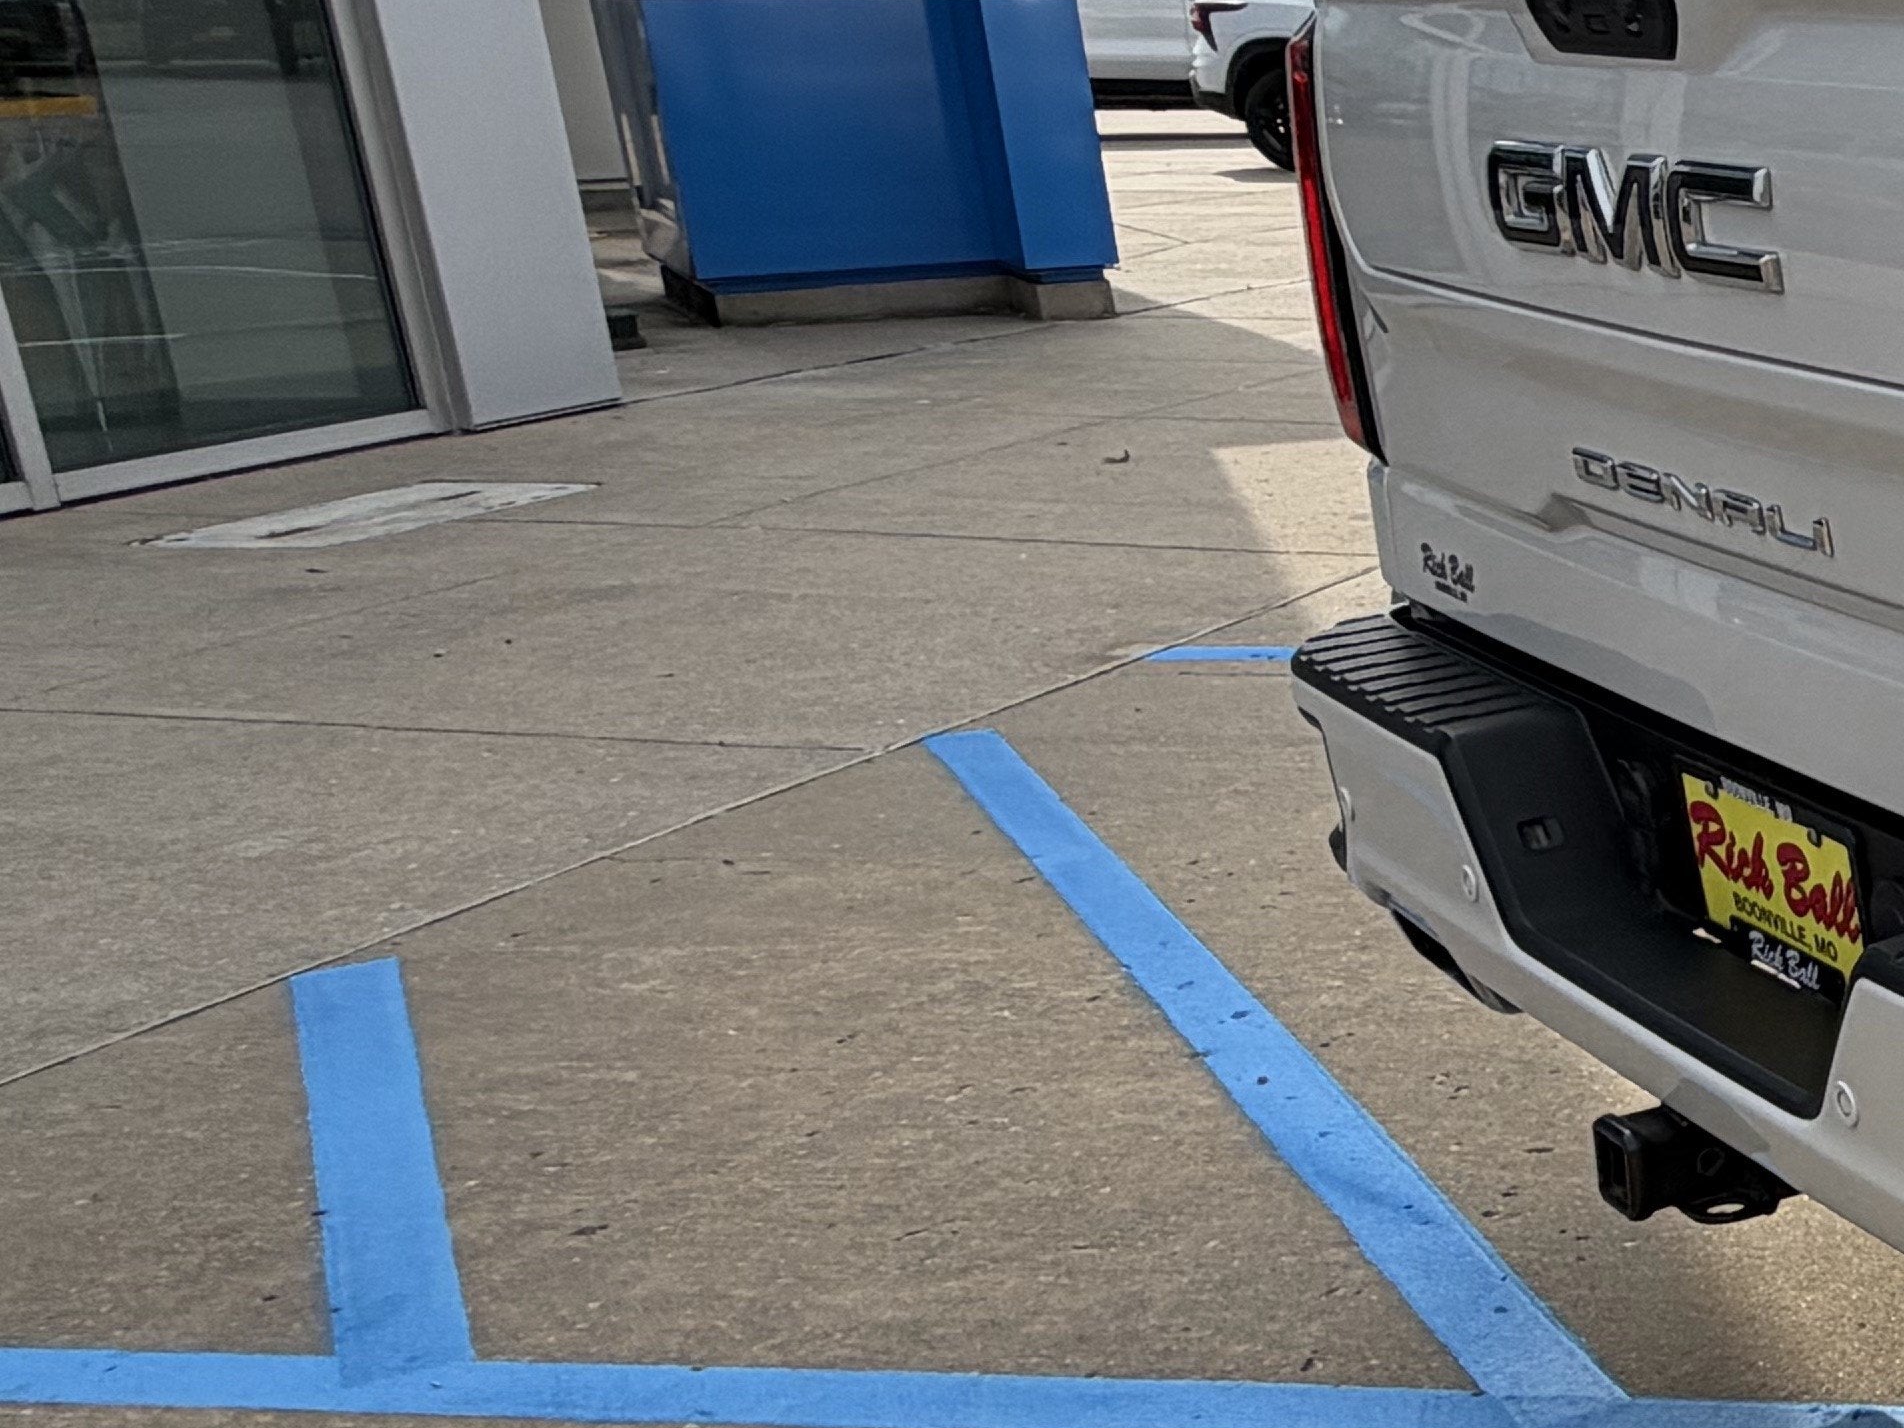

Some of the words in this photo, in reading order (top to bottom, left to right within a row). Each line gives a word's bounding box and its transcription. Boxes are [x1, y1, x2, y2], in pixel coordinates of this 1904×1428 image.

[1487, 139, 1785, 296] GMC
[1571, 446, 1835, 558] DENALI
[1689, 800, 1774, 902] Rick
[1776, 842, 1862, 945] Ball
[1749, 929, 1785, 971] Rick
[1784, 949, 1821, 991] Ball
[1814, 933, 1839, 962] MO
